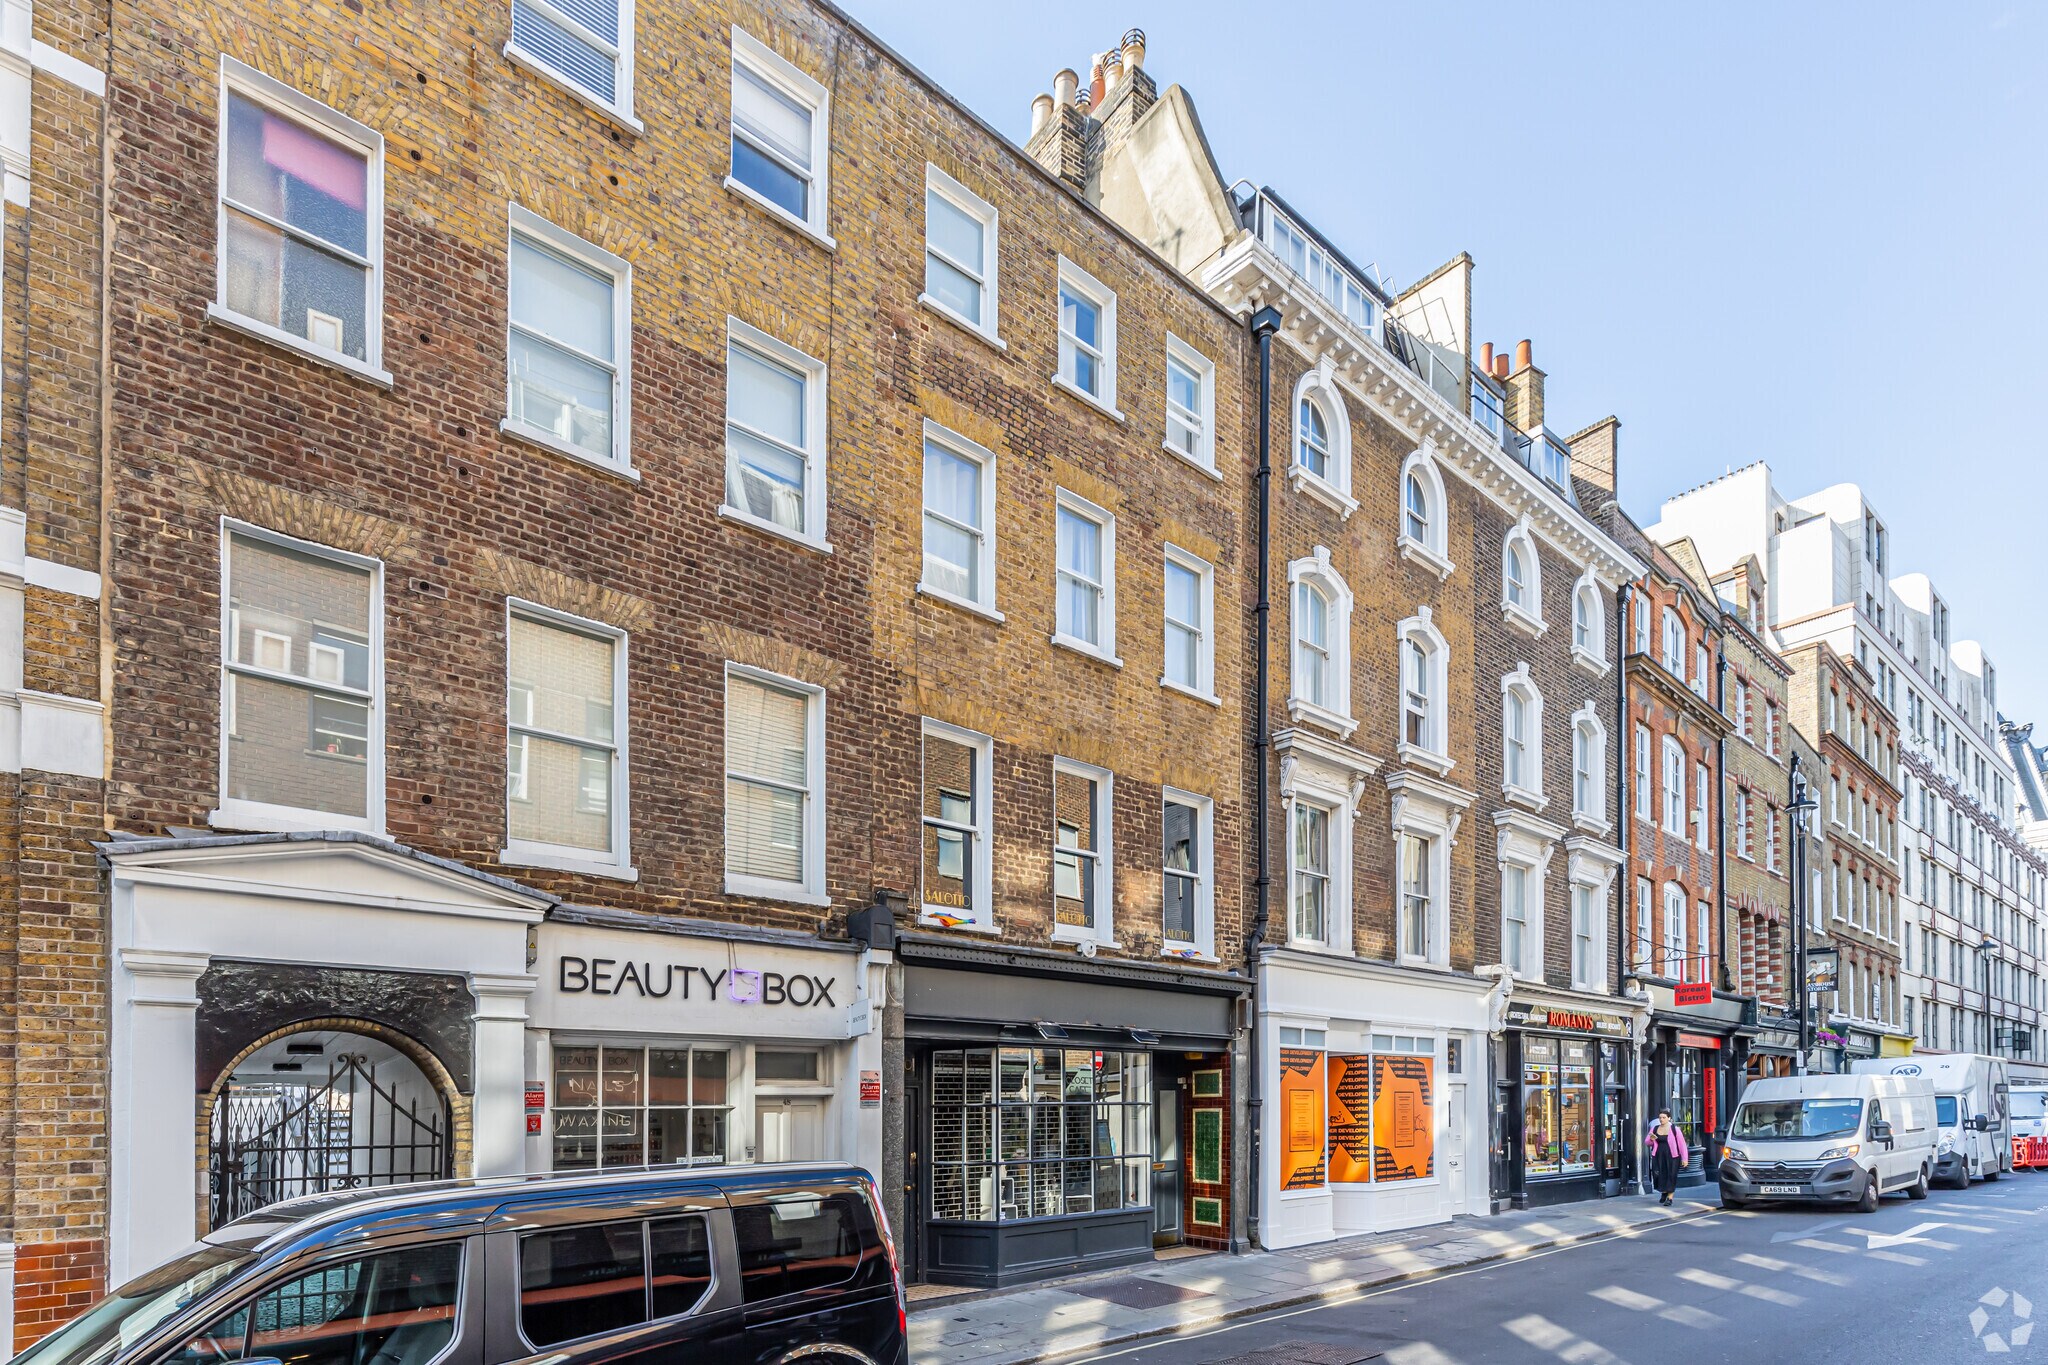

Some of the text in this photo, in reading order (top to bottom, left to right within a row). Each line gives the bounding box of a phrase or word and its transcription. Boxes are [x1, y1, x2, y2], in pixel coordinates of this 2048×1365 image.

[925, 890, 971, 907] SALOTTO
[560, 956, 835, 1007] BEAUTY BOX
[1550, 1011, 1594, 1030] ROMANYS
[609, 1057, 628, 1065] BOX
[570, 1078, 624, 1092] NALS
